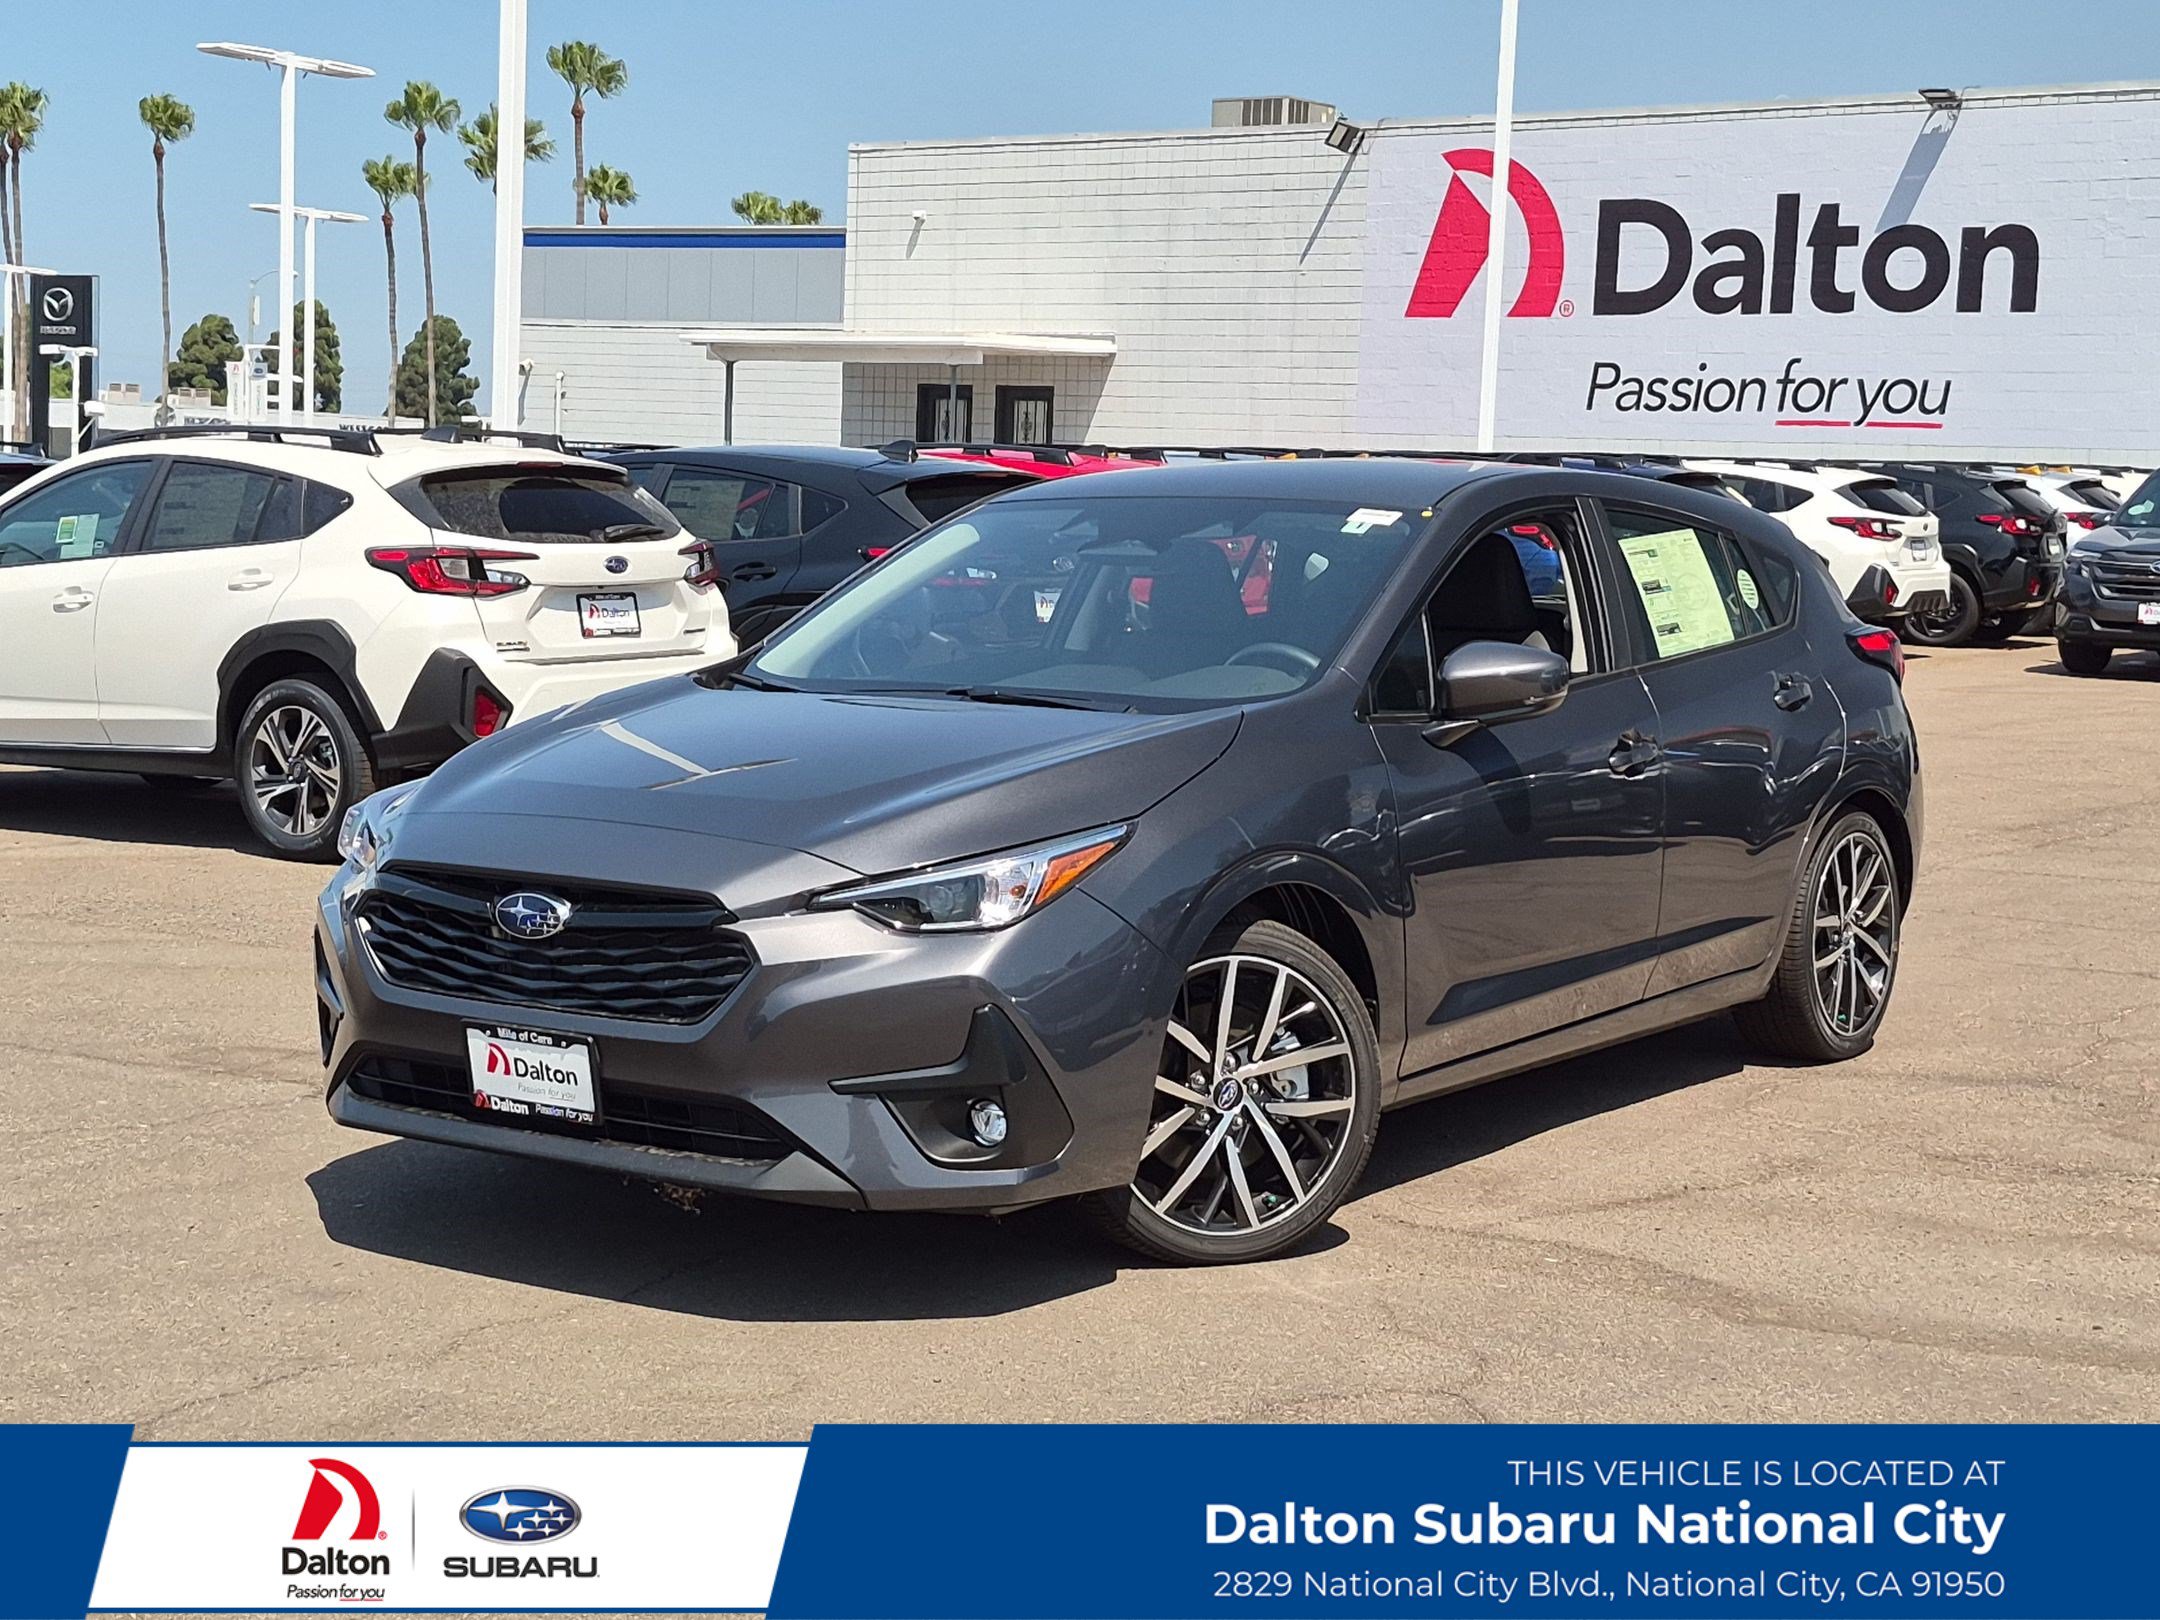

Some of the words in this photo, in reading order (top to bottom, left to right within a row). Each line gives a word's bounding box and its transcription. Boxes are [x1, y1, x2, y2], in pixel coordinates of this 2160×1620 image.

[1593, 193, 2040, 316] Dalton
[1586, 362, 1767, 412] Passion
[1775, 357, 1848, 413] for
[1853, 379, 1952, 427] you
[518, 1031, 529, 1042] of
[513, 1056, 578, 1087] Dalton
[518, 1083, 546, 1096] Passion
[549, 1087, 560, 1098] for
[561, 1091, 577, 1101] you
[490, 1095, 530, 1115] Dalton
[535, 1103, 565, 1117] Passion
[565, 1108, 578, 1119] for
[577, 1112, 594, 1123] you
